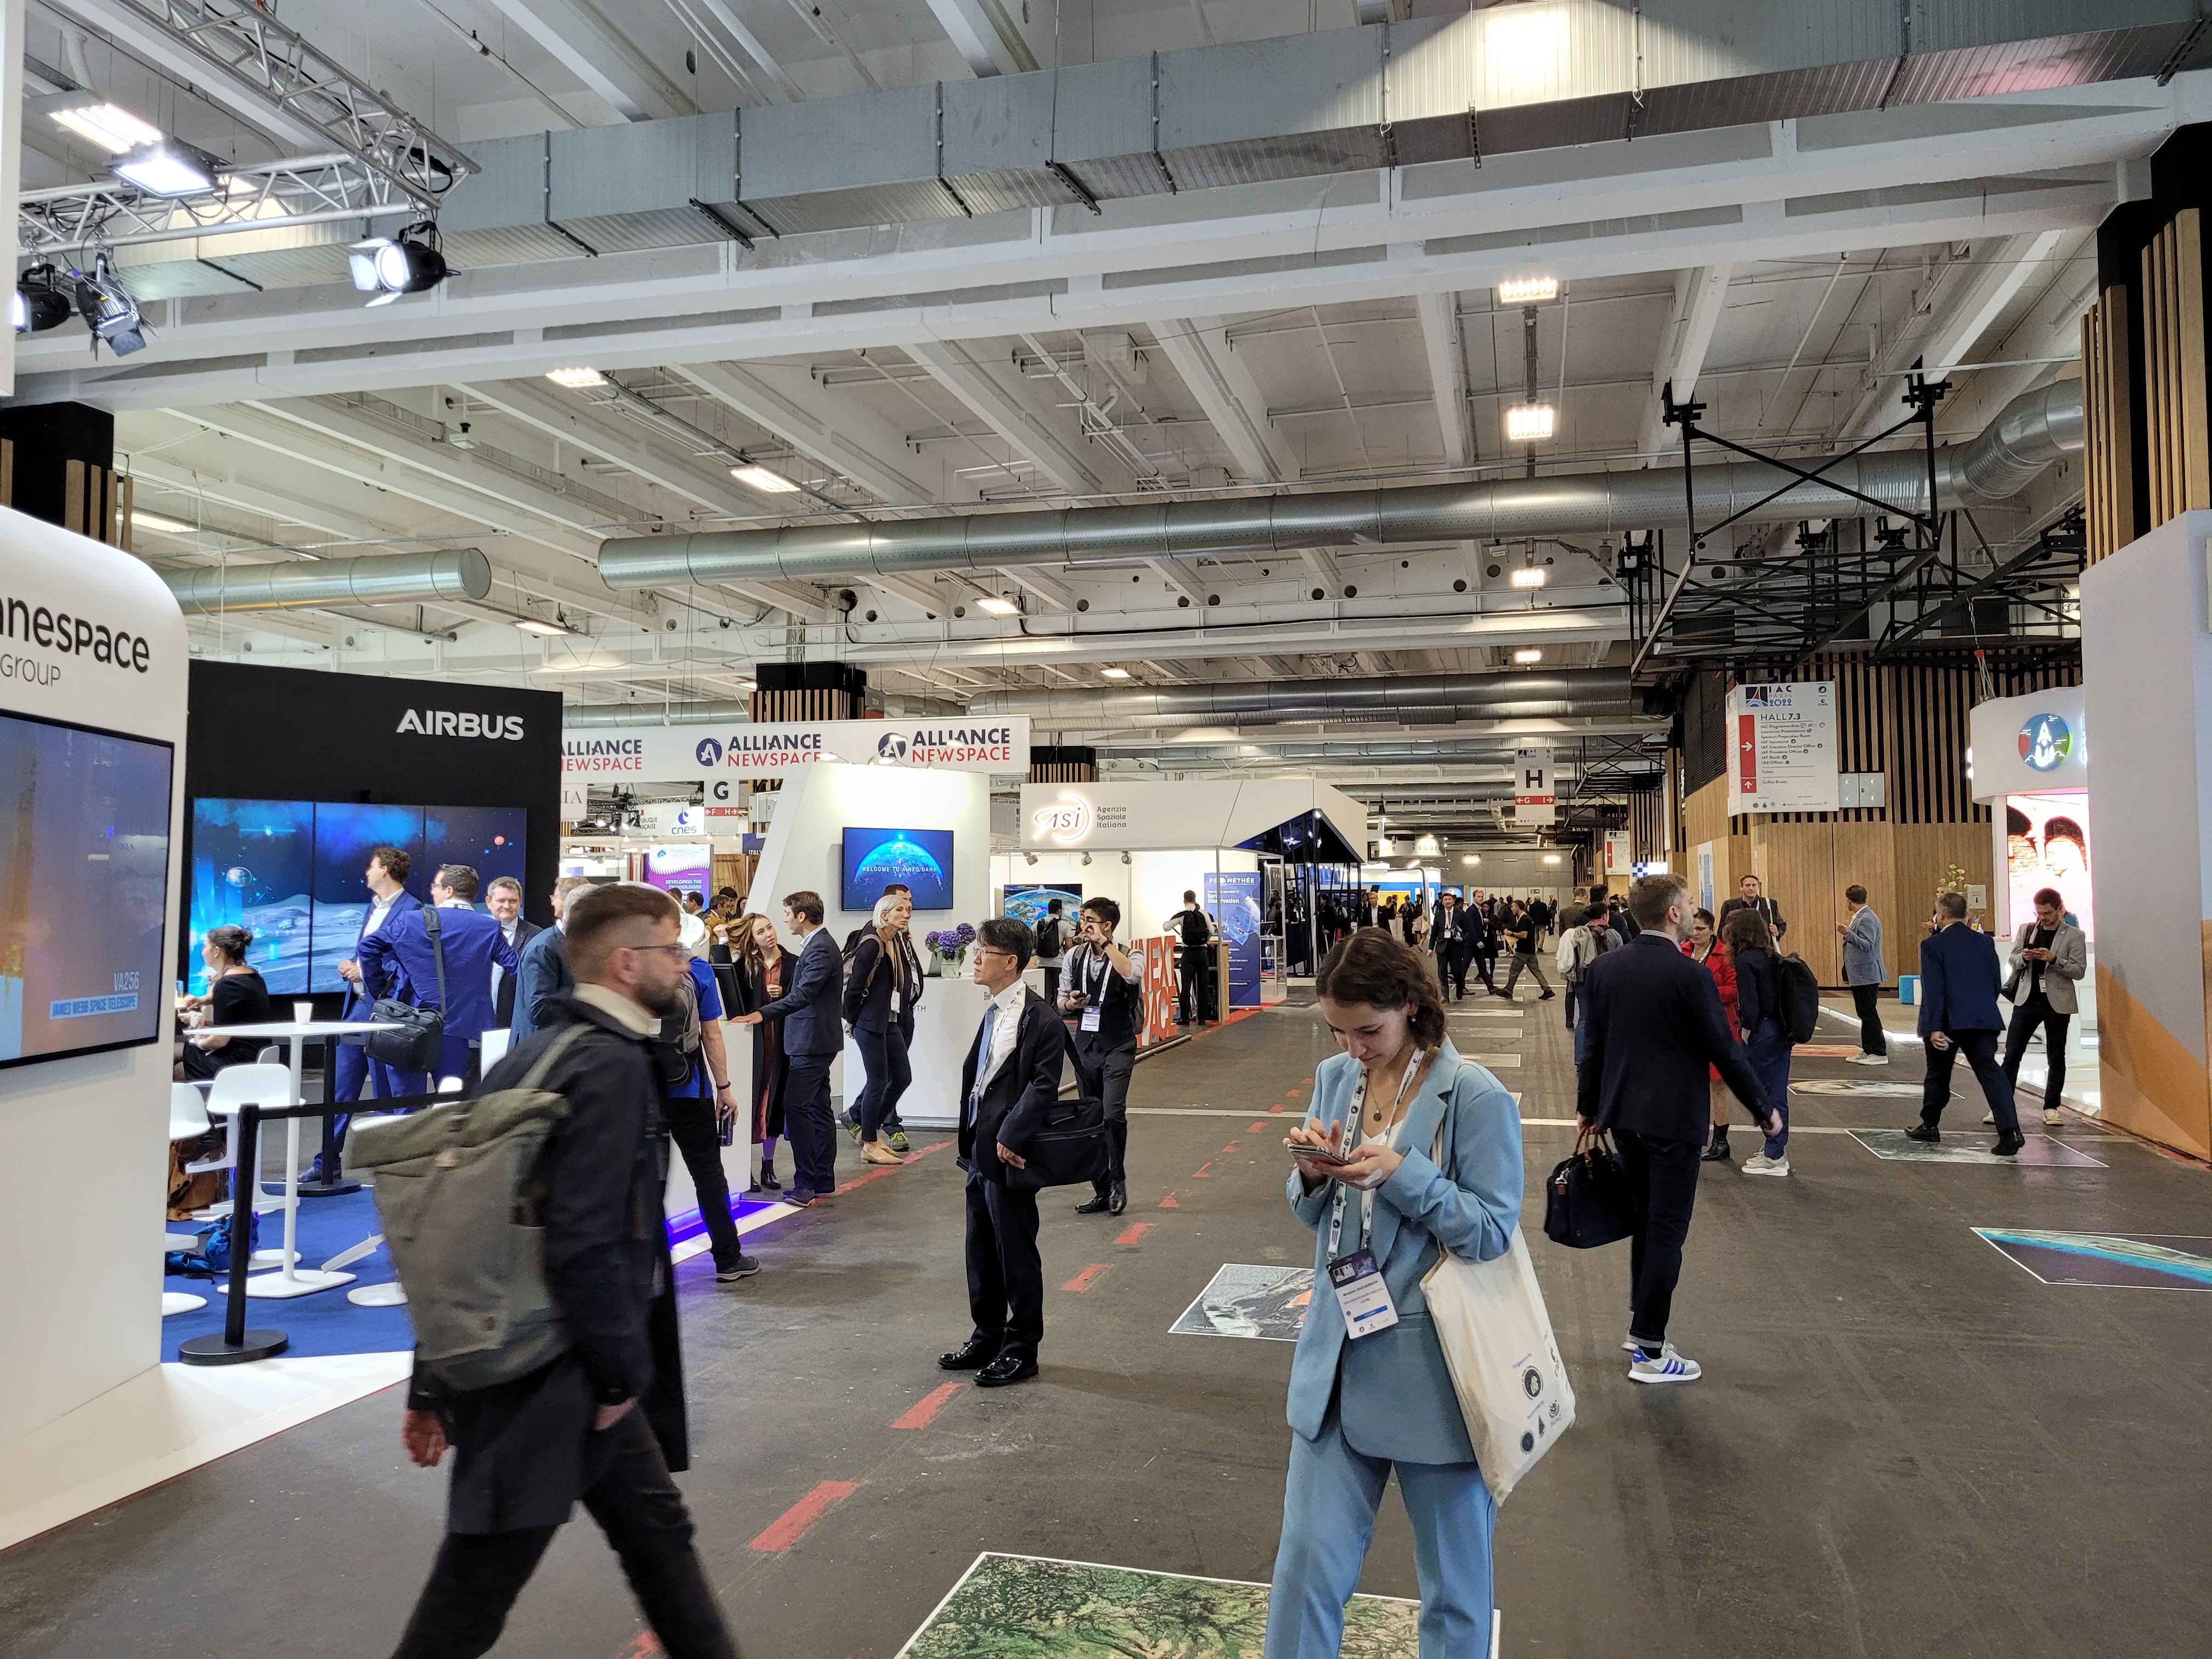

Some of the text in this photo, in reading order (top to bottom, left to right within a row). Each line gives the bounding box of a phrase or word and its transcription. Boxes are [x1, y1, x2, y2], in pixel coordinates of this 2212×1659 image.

[0, 597, 150, 673] nespace
[396, 709, 524, 741] AIRBUS
[728, 734, 821, 751] ALLIANCE
[912, 728, 1010, 746] ALLIANCE
[912, 747, 1010, 763] NEWSPACE
[1526, 770, 1543, 788] H
[714, 781, 729, 800] G
[672, 826, 697, 834] cnes
[114, 972, 139, 991] VA256
[52, 995, 136, 1016] JAMES WEBB SPACE TELESCOPE
